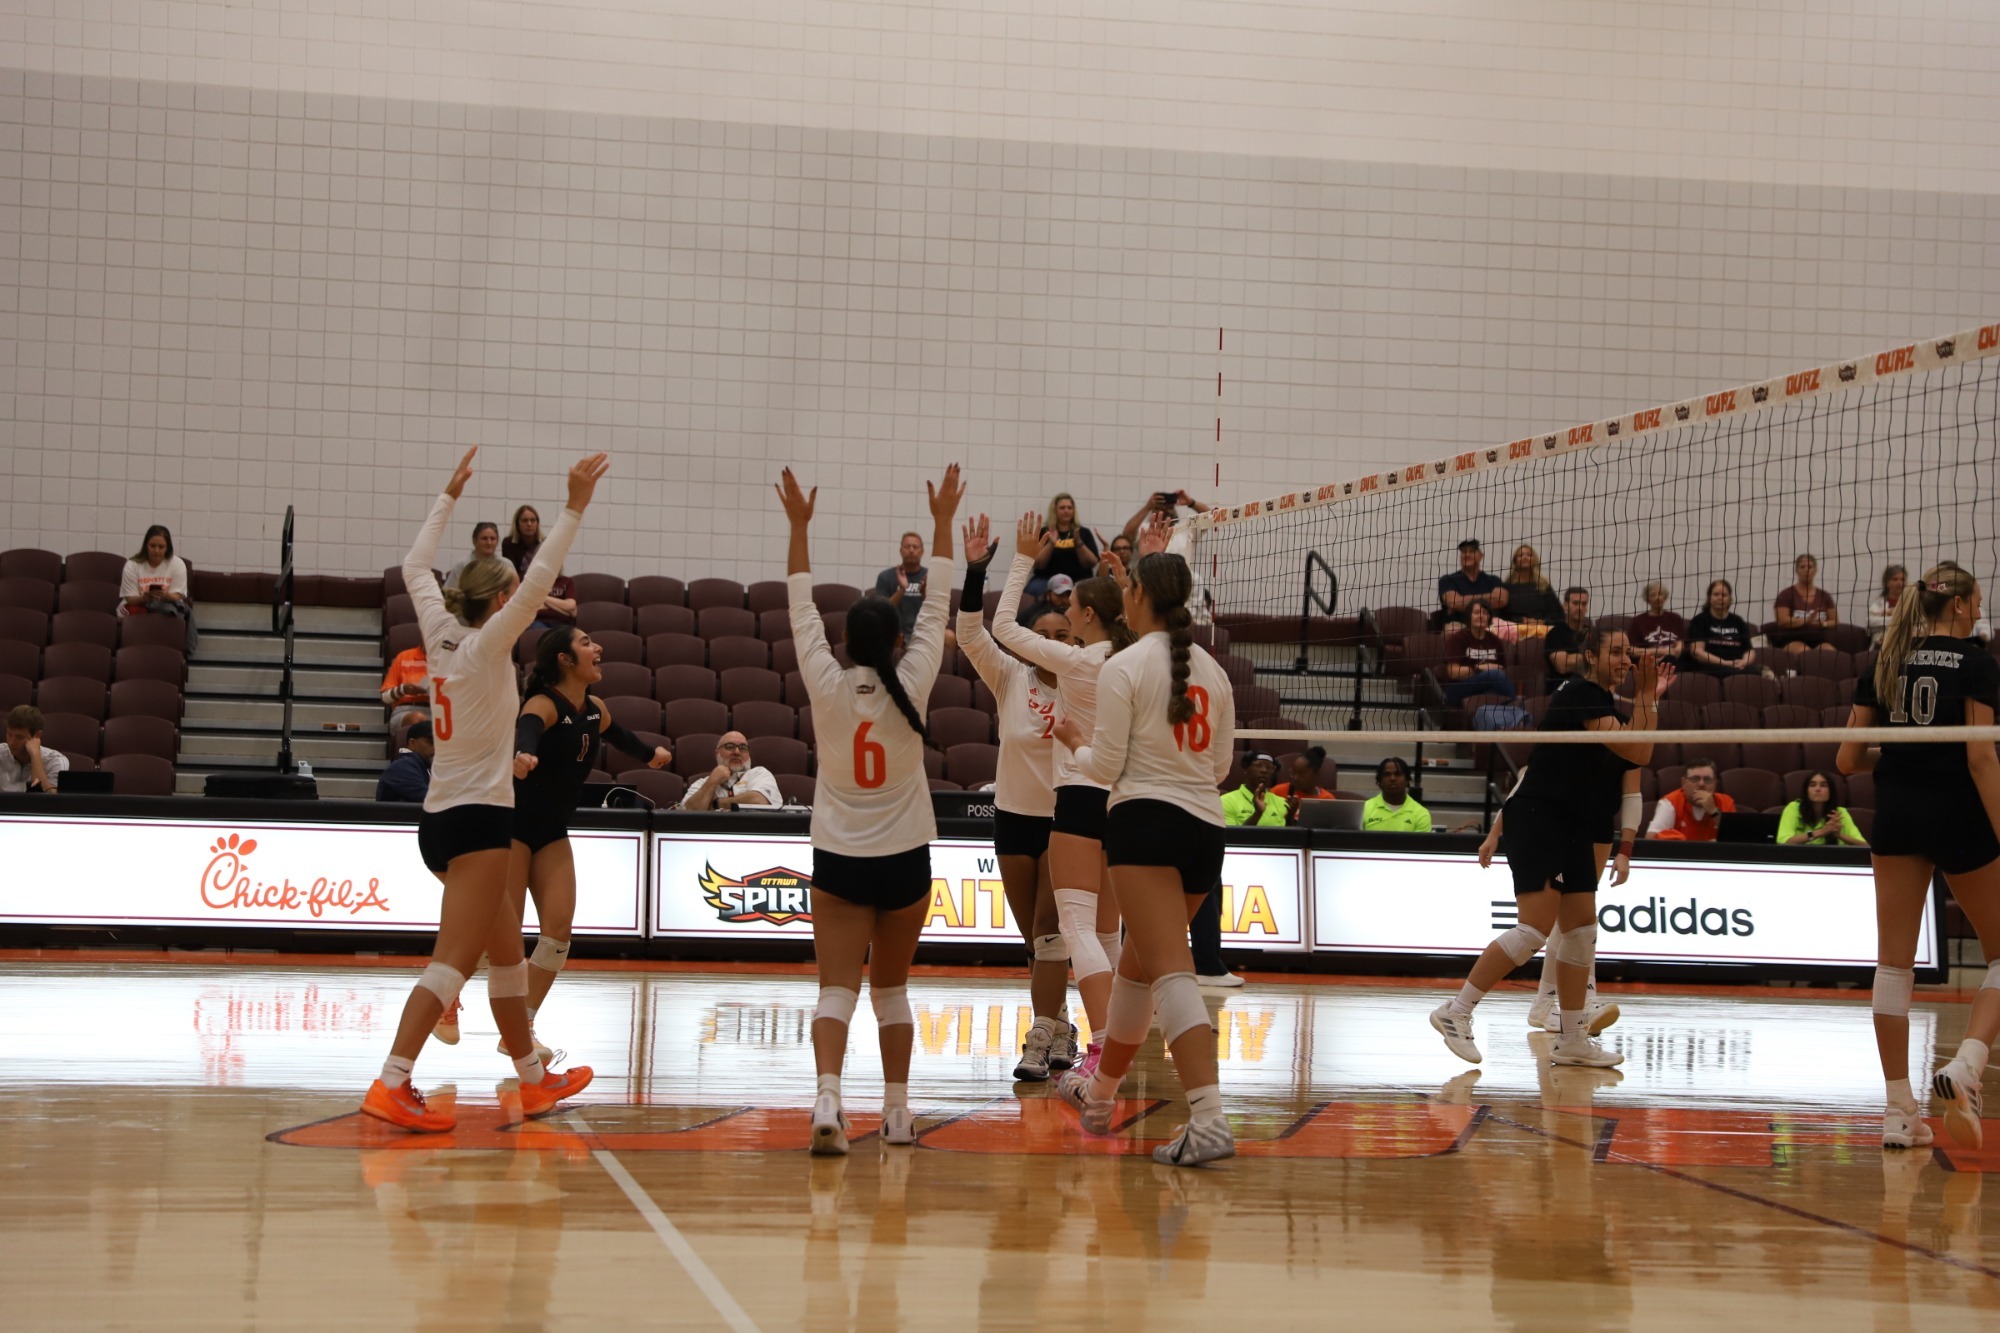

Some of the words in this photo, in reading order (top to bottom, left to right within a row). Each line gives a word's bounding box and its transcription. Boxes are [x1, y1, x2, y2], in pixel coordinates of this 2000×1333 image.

[1977, 324, 2000, 352] OU
[1890, 675, 1938, 725] 10
[577, 733, 589, 761] 1
[854, 721, 886, 788] 6
[968, 804, 995, 817] POSS
[200, 852, 390, 918] Chick-fil-A
[760, 878, 799, 886] OTTAWA
[719, 887, 812, 914] SPIRI
[1598, 896, 1755, 937] adidas
